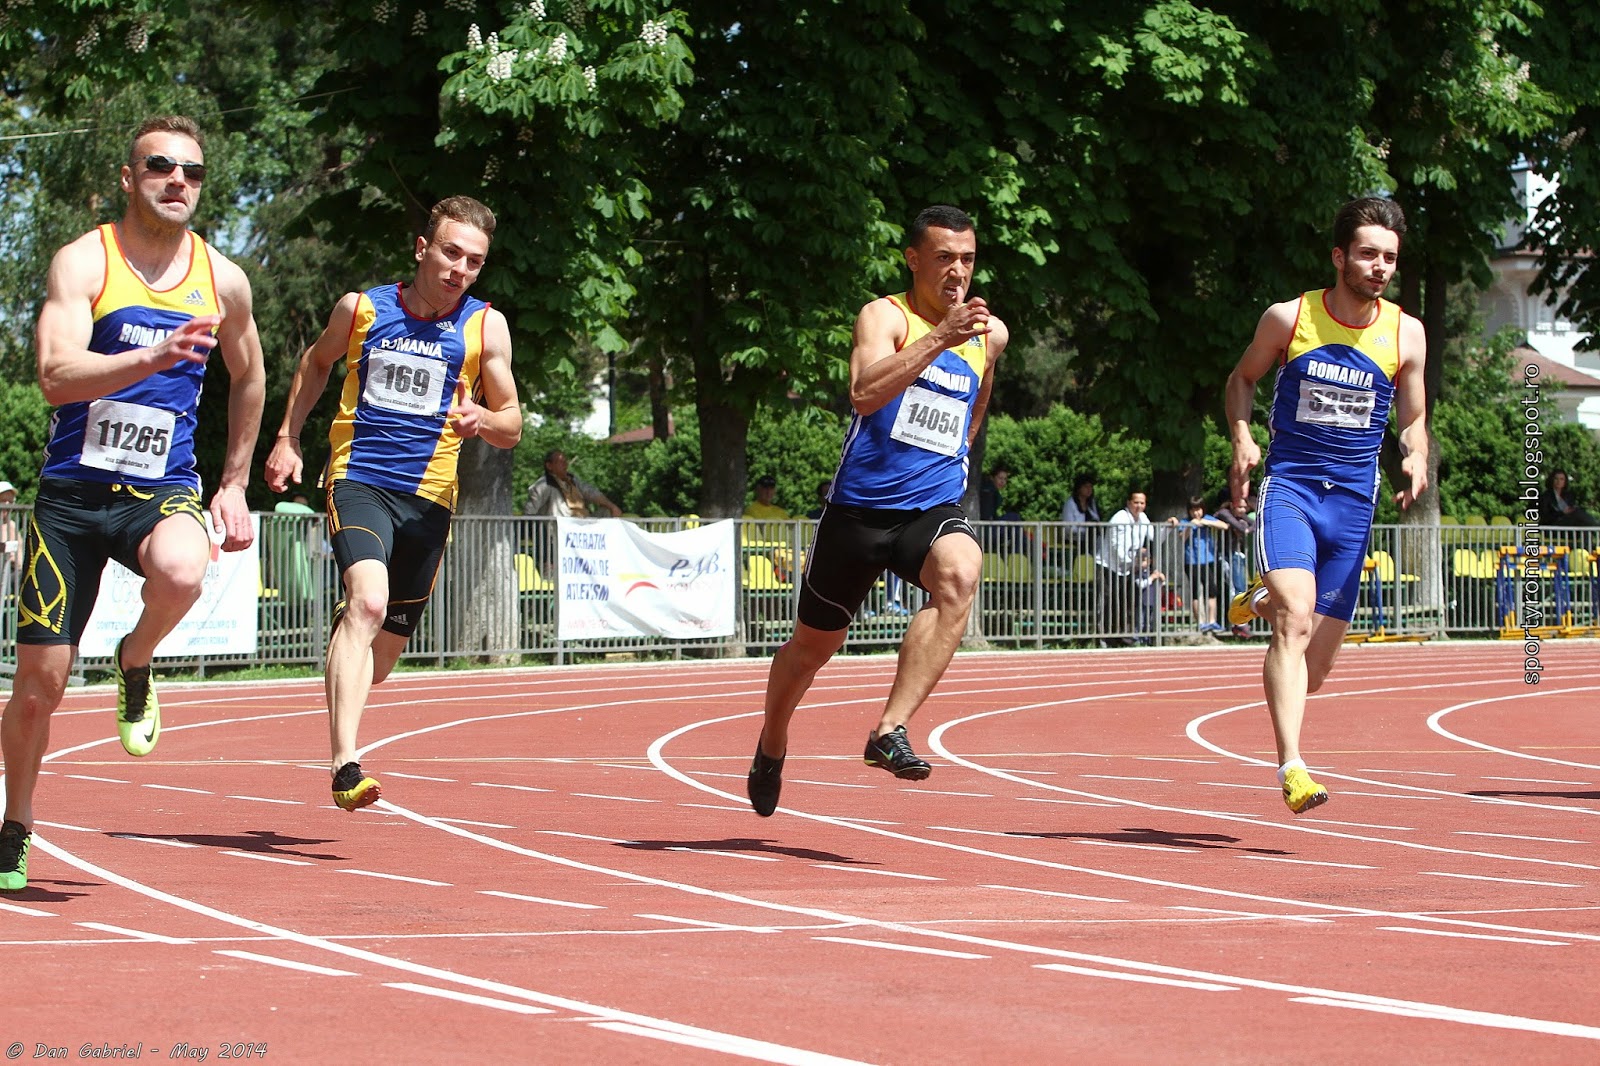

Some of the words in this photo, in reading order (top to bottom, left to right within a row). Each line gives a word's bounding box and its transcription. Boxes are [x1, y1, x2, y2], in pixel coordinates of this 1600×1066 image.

[380, 336, 444, 359] ROMANIA
[383, 363, 431, 397] 169
[918, 364, 971, 394] ROMANIA
[1306, 359, 1375, 389] ROMANIA
[907, 402, 961, 438] 14054
[97, 419, 170, 457] 11265
